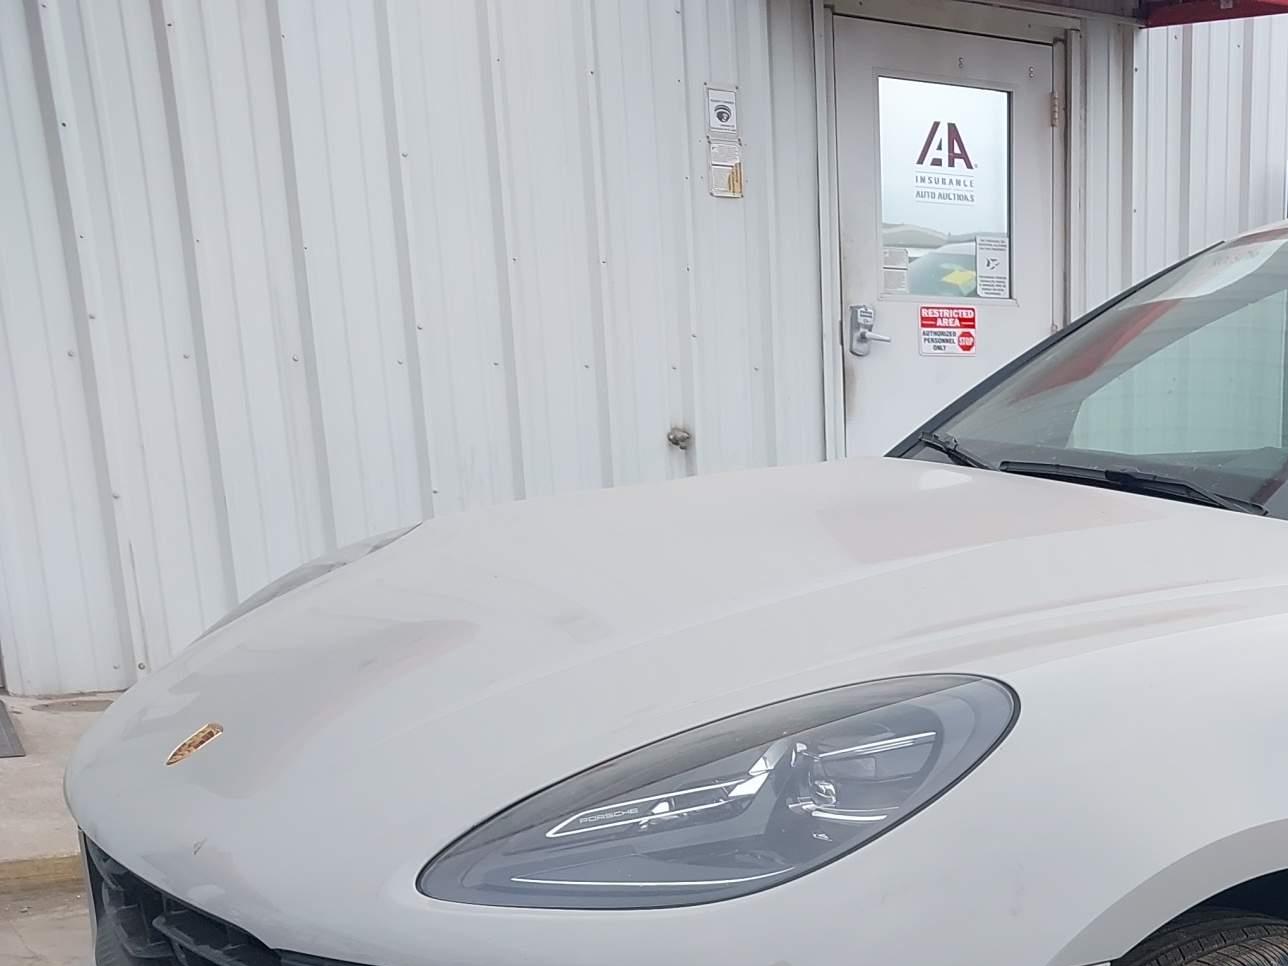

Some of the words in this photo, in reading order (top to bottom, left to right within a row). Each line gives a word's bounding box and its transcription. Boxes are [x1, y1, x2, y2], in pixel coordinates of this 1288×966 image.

[915, 175, 975, 188] INSURANCE
[915, 190, 936, 201] AUTO
[937, 191, 975, 203] AUCTIONS
[921, 307, 975, 320] RESTRICTED
[936, 318, 960, 328] AREA
[922, 329, 957, 338] AUTHORIZED
[923, 336, 956, 346] PERSONNEL
[959, 335, 974, 347] STOP
[932, 344, 947, 352] ONLY
